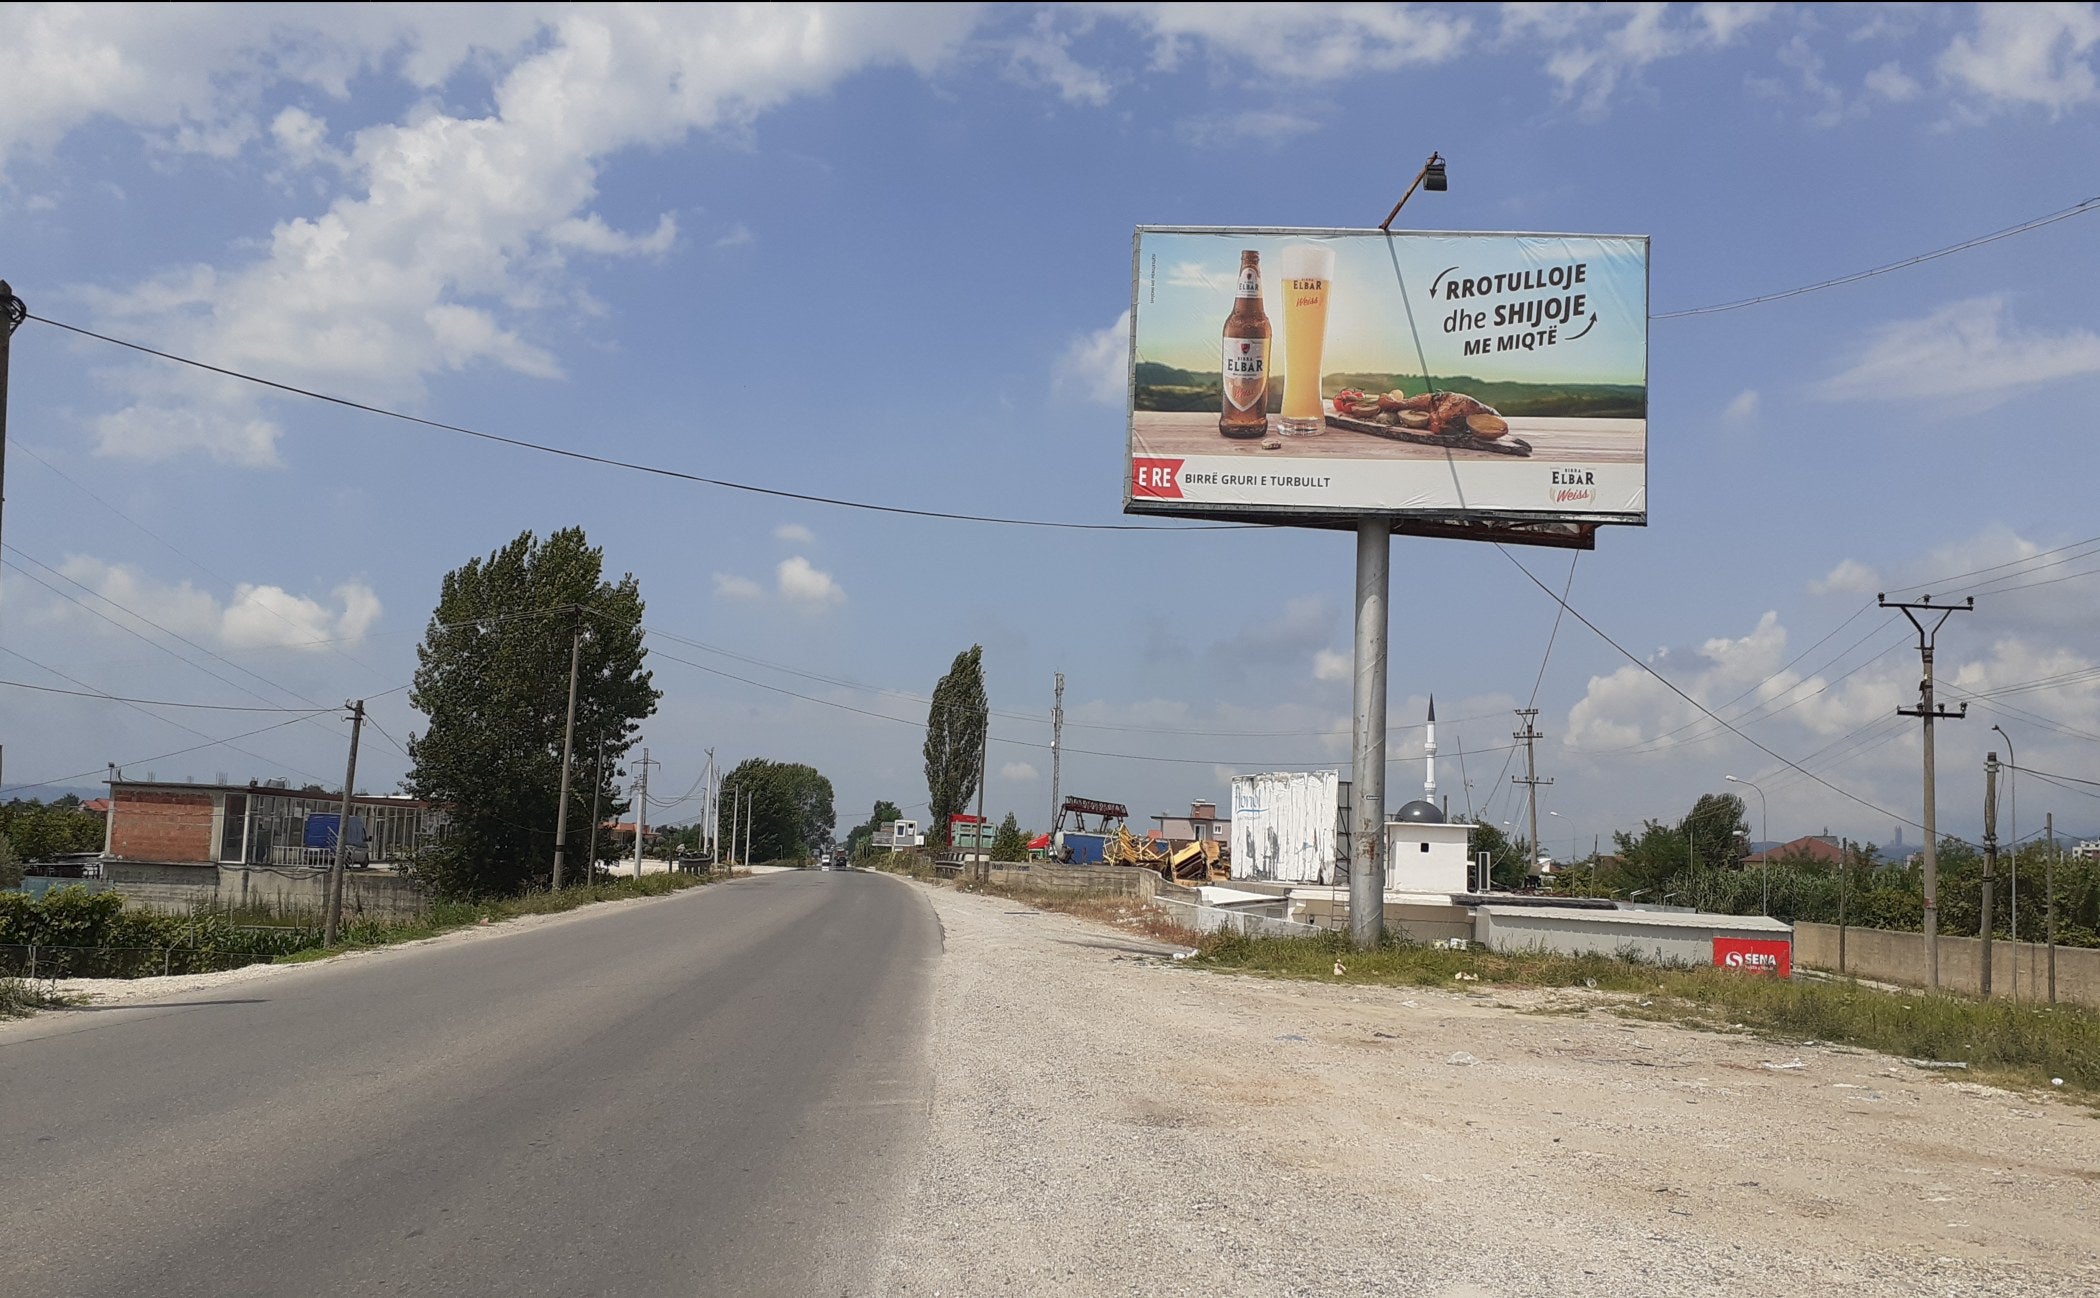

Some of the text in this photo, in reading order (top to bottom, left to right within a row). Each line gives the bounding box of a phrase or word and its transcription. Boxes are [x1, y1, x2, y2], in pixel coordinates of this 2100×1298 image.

[1293, 280, 1322, 290] ELBAR
[1446, 263, 1587, 301] RROTULLOJE
[1443, 294, 1587, 333] dhe SHIJOJE
[1463, 325, 1558, 356] ME MIQTË
[1227, 358, 1263, 372] ELBAR
[1138, 467, 1172, 487] E RE
[1185, 472, 1331, 487] BIRRË GRURI E TURBULLT
[1552, 471, 1594, 485] ELBAR
[1556, 488, 1589, 503] Weiss
[1744, 953, 1777, 966] SENA
